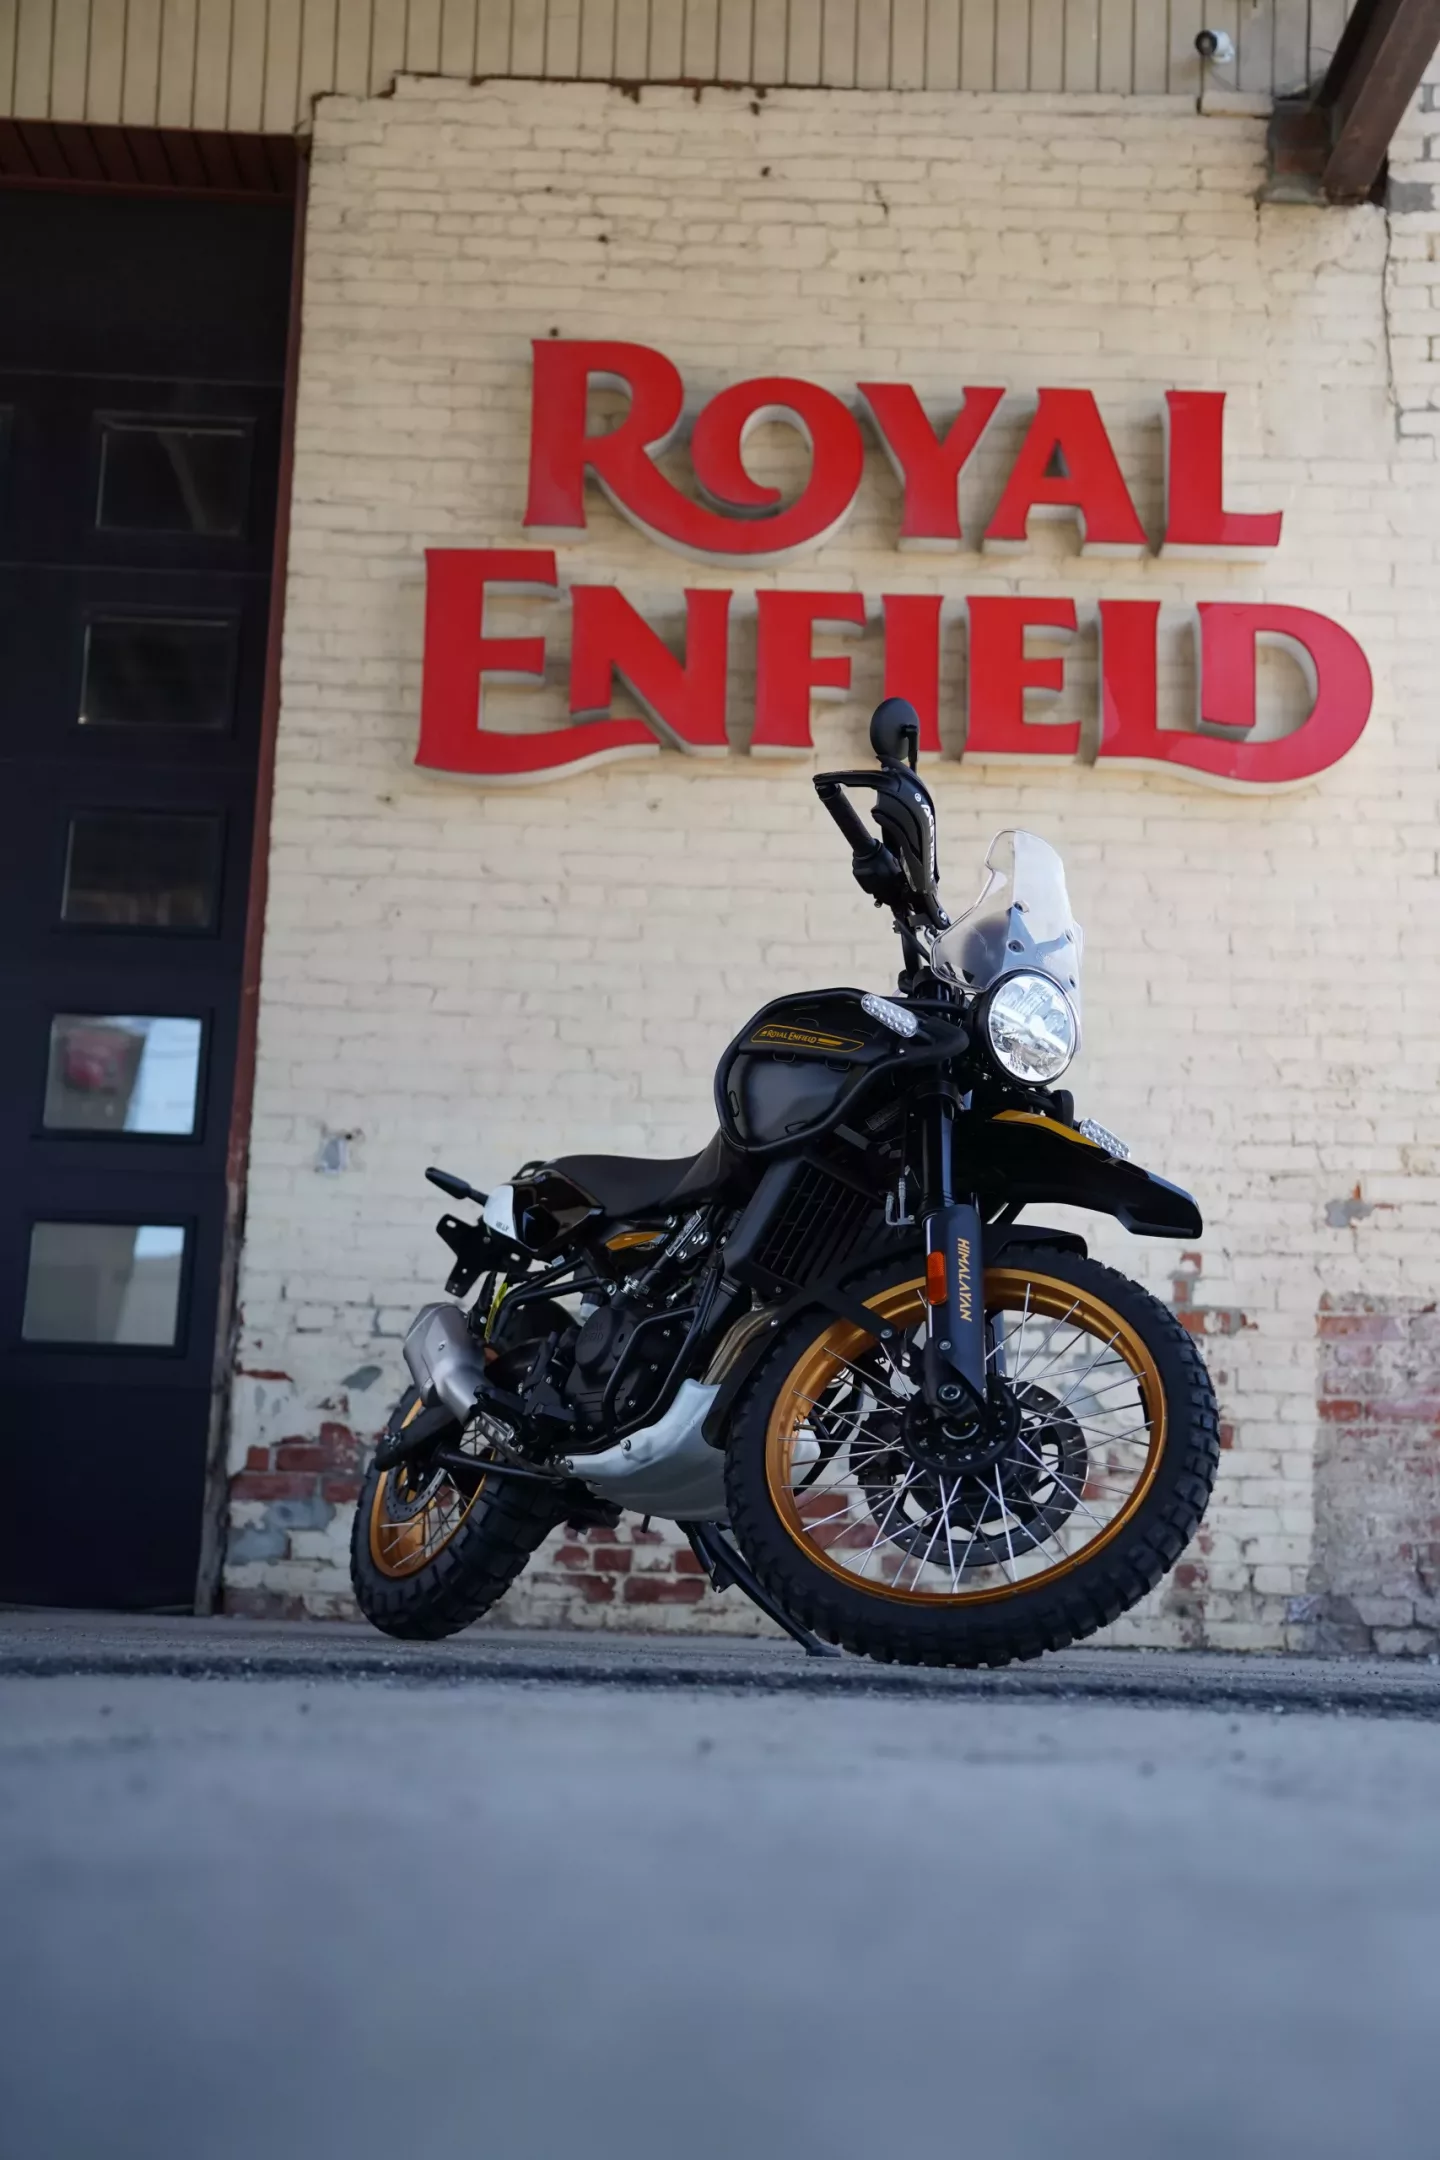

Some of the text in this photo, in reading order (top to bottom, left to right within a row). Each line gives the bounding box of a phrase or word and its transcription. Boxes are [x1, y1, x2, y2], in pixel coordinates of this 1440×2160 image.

[522, 338, 1284, 560] ROYAL
[414, 548, 1375, 785] ENFIELD
[767, 1030, 816, 1043] ROYAL ENFIELD
[956, 1236, 973, 1323] HIMALAYAN
